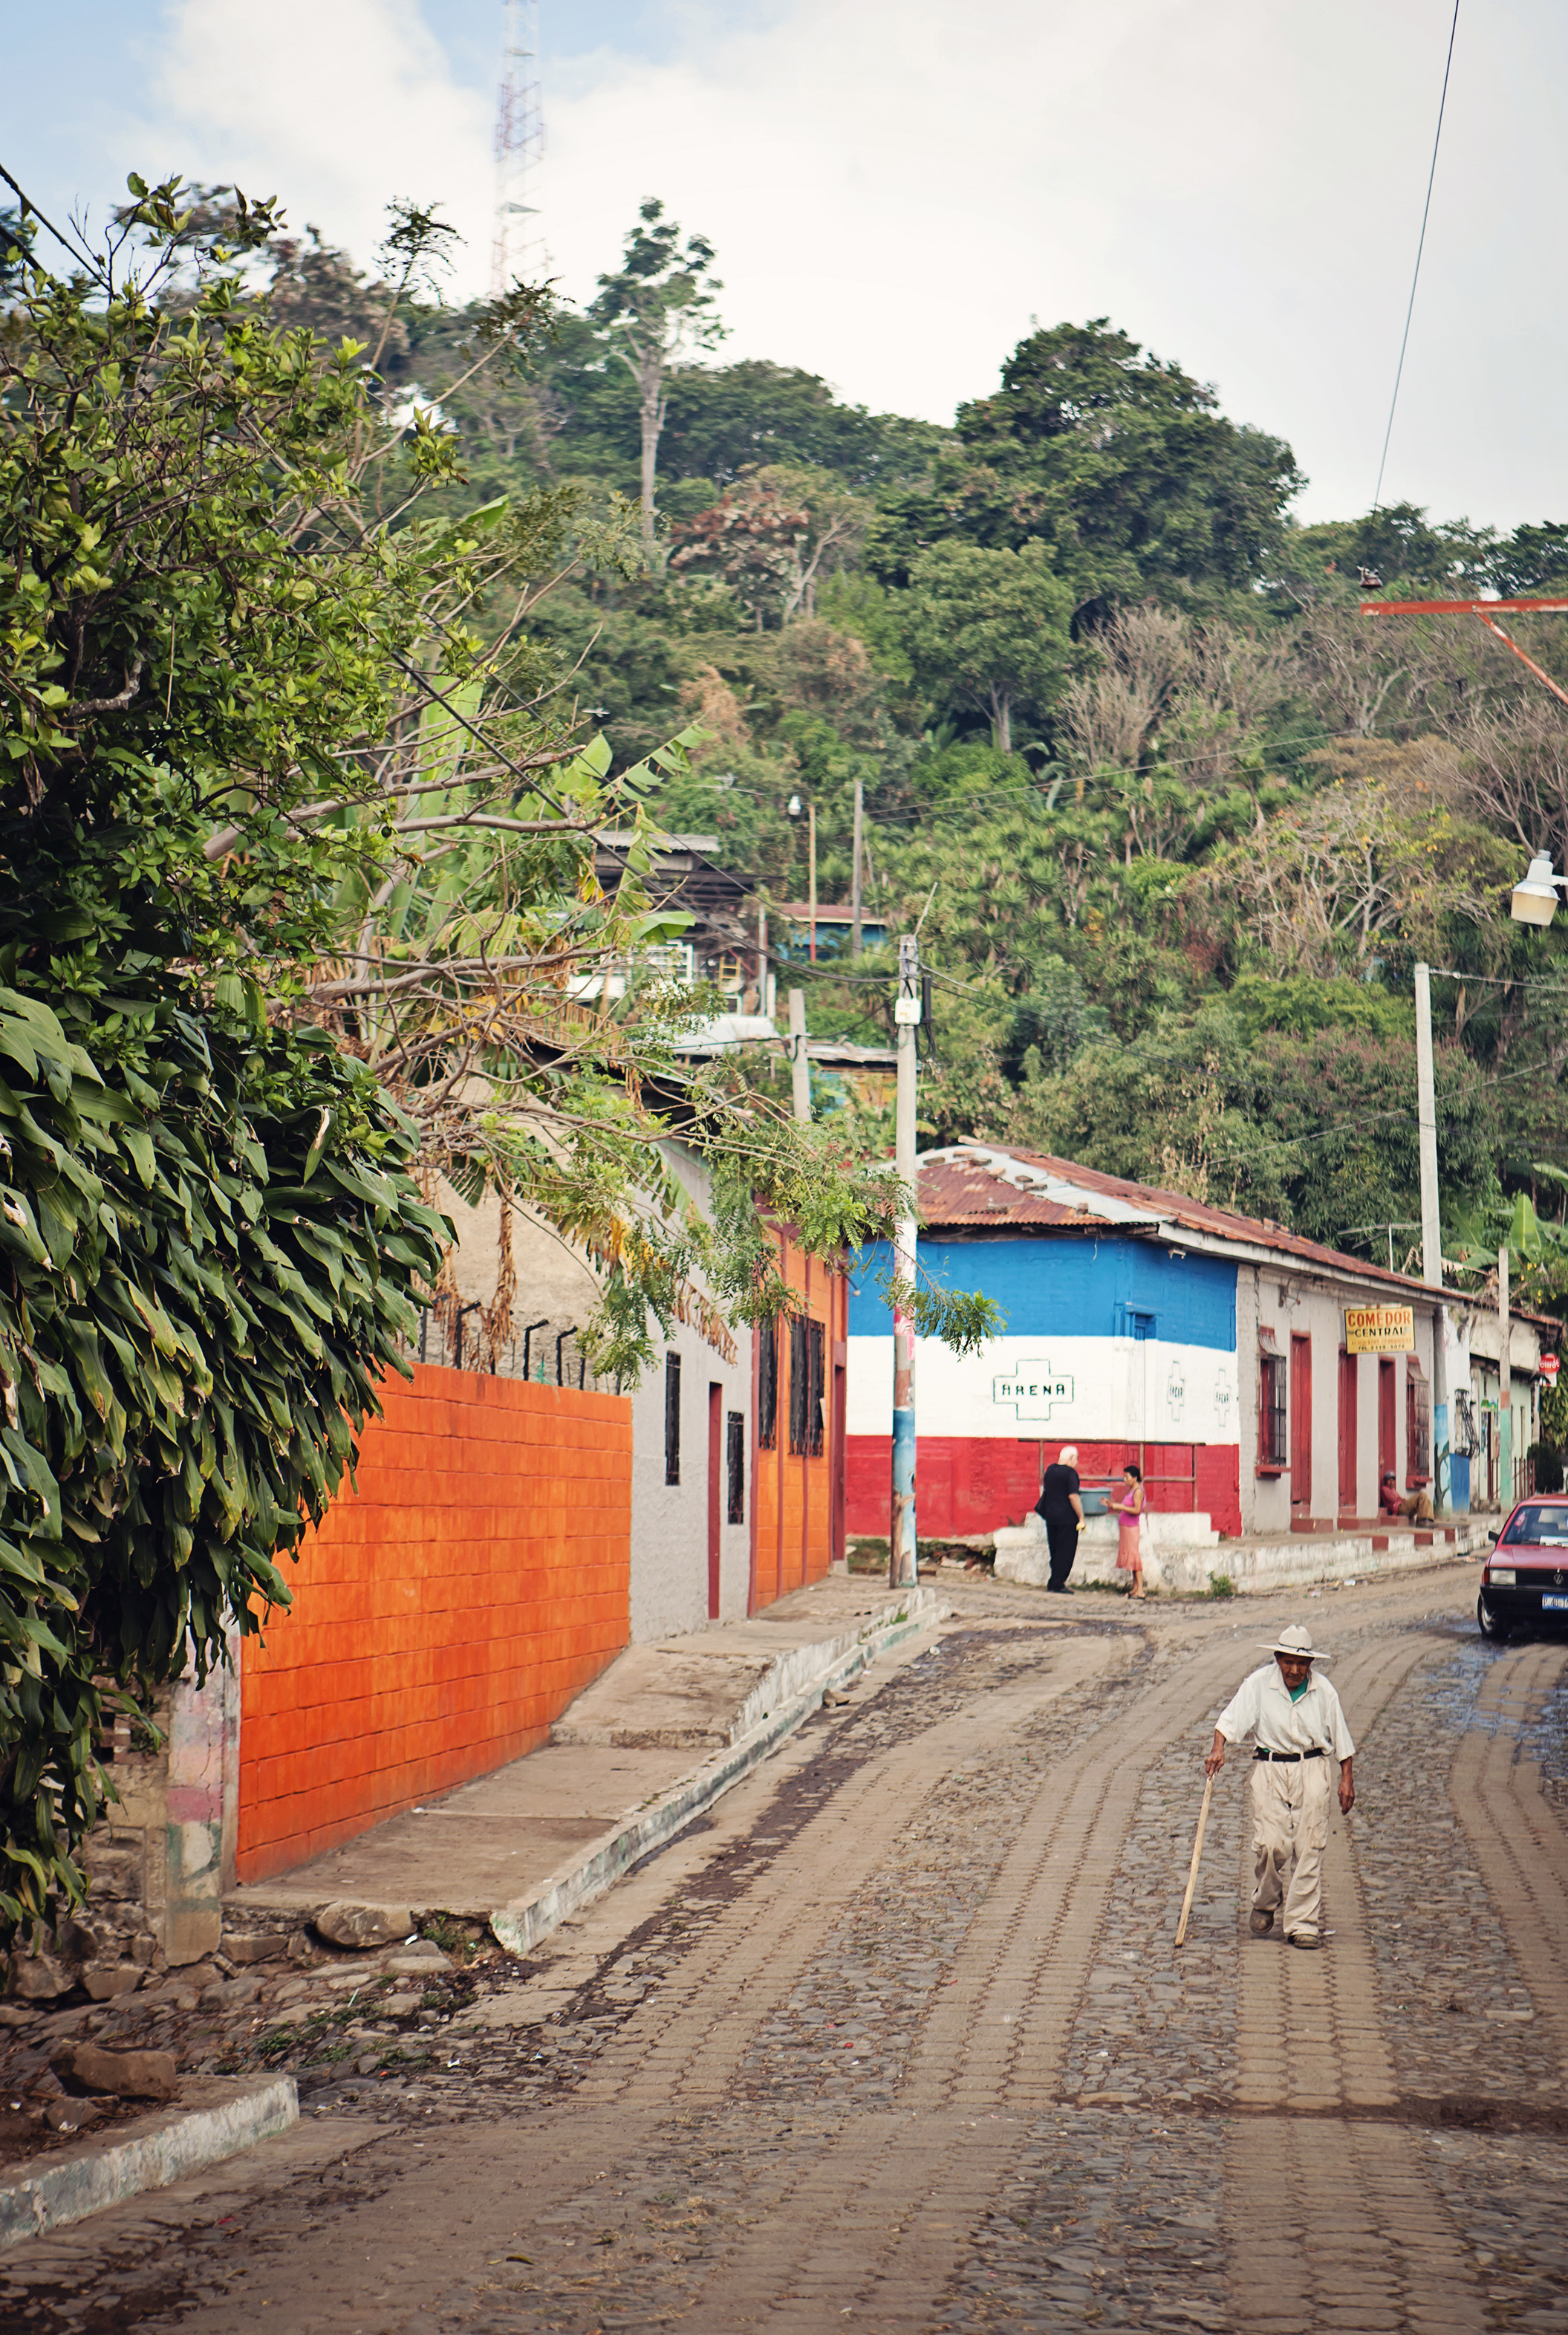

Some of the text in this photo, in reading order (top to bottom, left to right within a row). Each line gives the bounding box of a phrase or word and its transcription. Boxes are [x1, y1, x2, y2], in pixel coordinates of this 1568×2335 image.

[1348, 1311, 1411, 1328] COMEDOR
[1355, 1326, 1406, 1338] CENTRAL
[1002, 1384, 1064, 1395] ARENA
